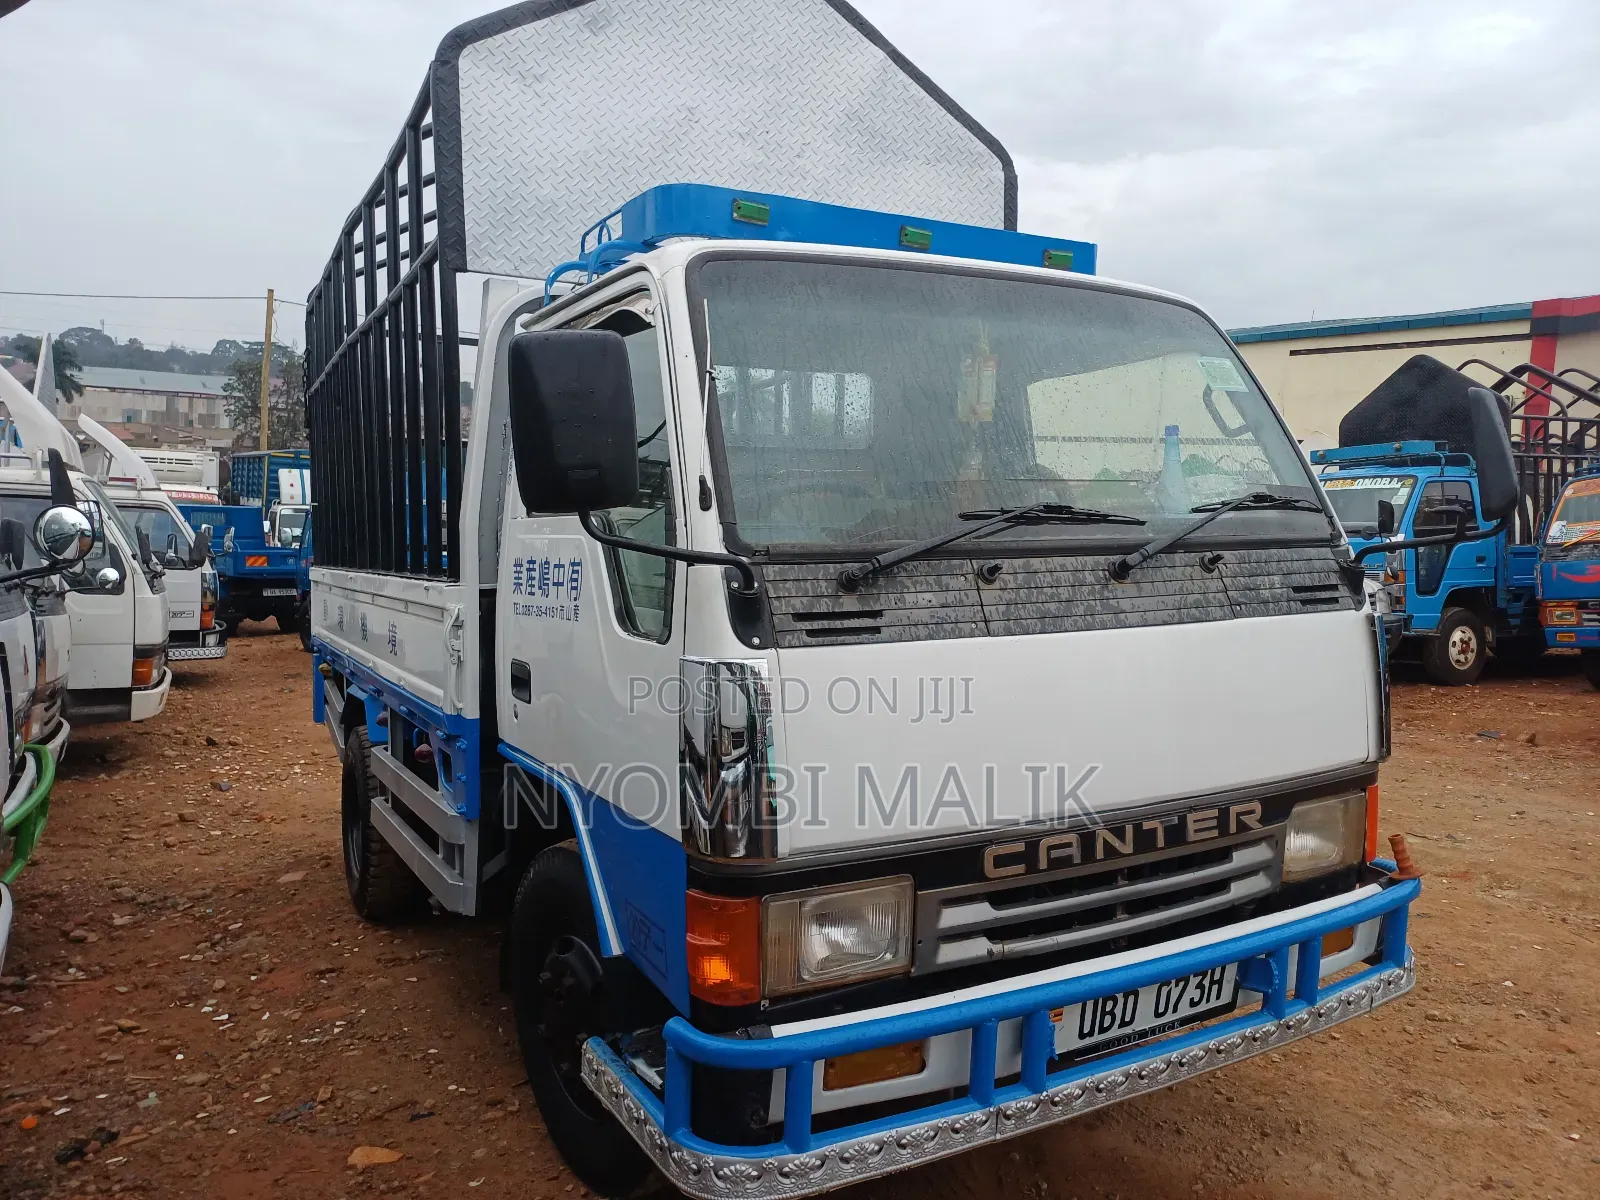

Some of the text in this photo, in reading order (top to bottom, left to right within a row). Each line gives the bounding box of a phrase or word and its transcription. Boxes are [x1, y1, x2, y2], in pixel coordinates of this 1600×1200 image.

[984, 801, 1264, 879] CANTER
[1077, 964, 1227, 1041] UBD 073H
[1099, 1020, 1181, 1052] GOOD LUCK
